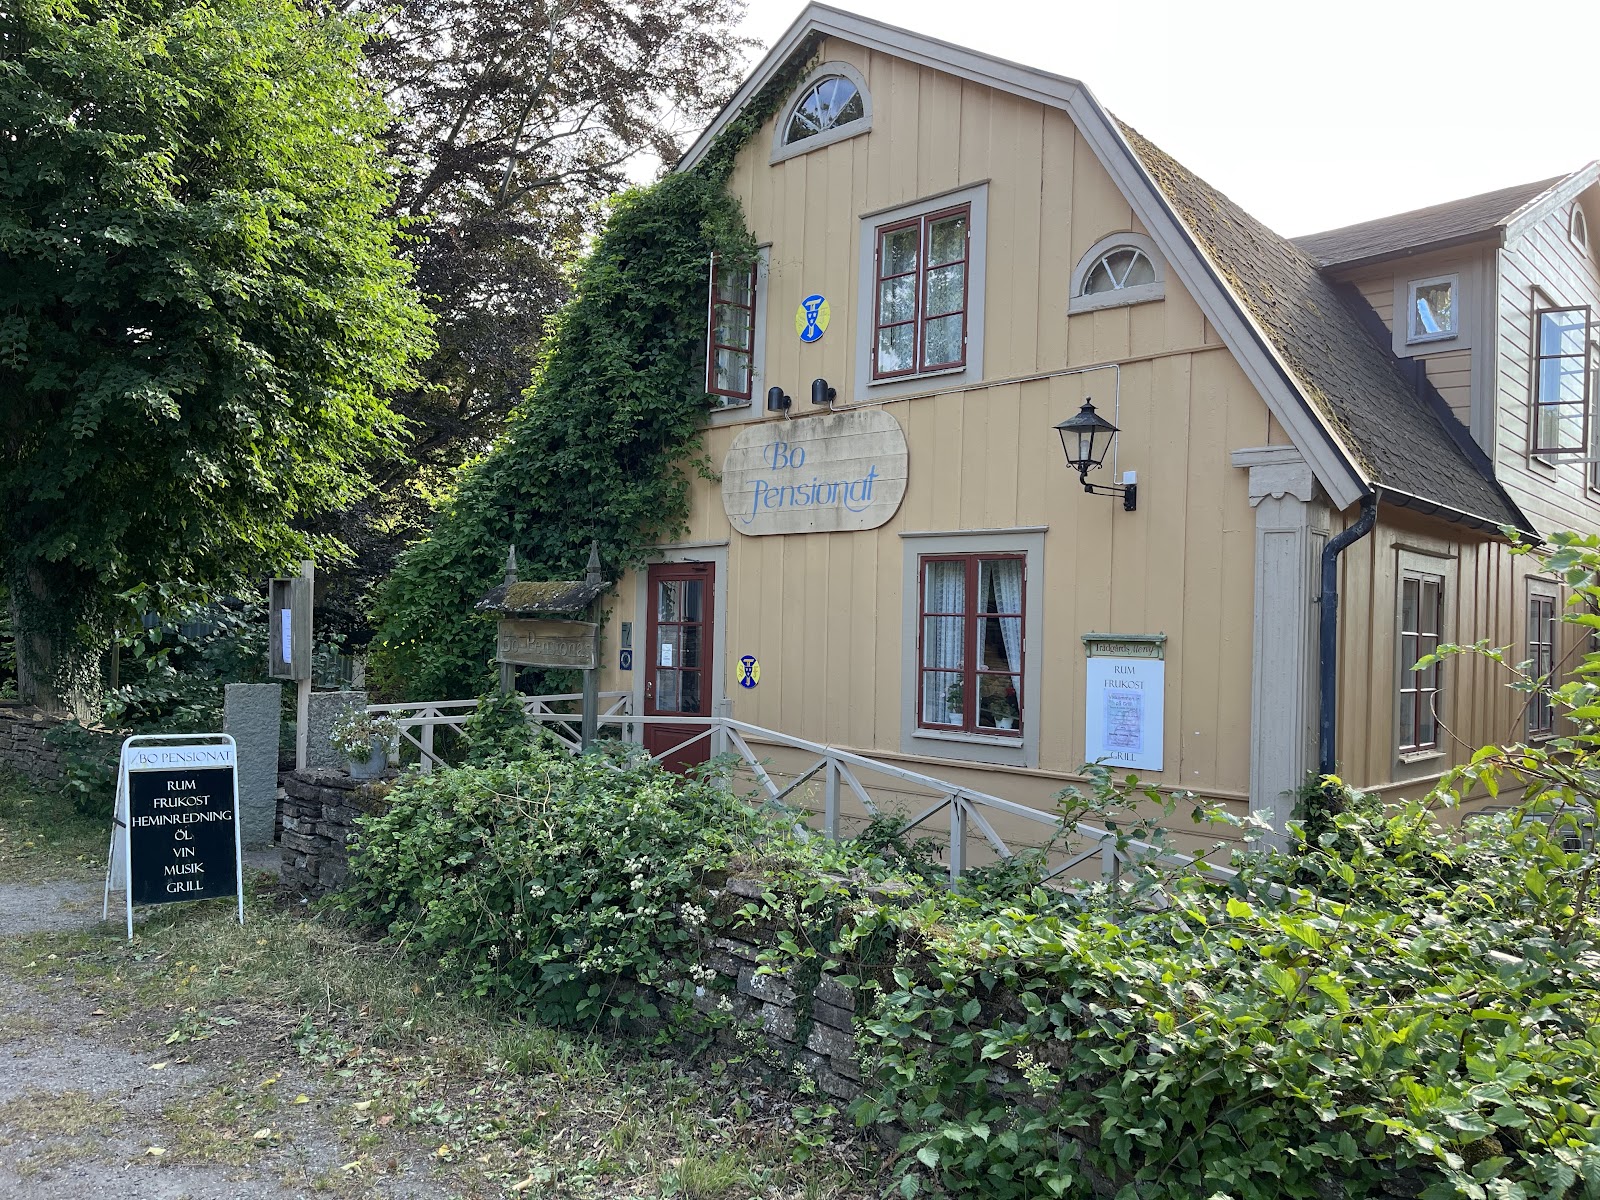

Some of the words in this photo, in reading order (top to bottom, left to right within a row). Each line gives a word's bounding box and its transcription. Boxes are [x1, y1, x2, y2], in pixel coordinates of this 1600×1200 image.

[763, 441, 806, 471] Bo
[741, 464, 879, 524] Pensionat
[1114, 665, 1136, 675] RUM
[1104, 679, 1144, 690] FRUKOST
[161, 751, 232, 763] PENSIONAT
[1110, 751, 1137, 762] GRILL
[167, 780, 196, 791] RUM
[153, 795, 210, 808] FRUKOST
[132, 810, 232, 827] HEMINREDNING
[174, 829, 193, 841] ÖL
[173, 847, 195, 858] VIN
[164, 862, 205, 876] MUSIK
[166, 882, 204, 893] GRILL
